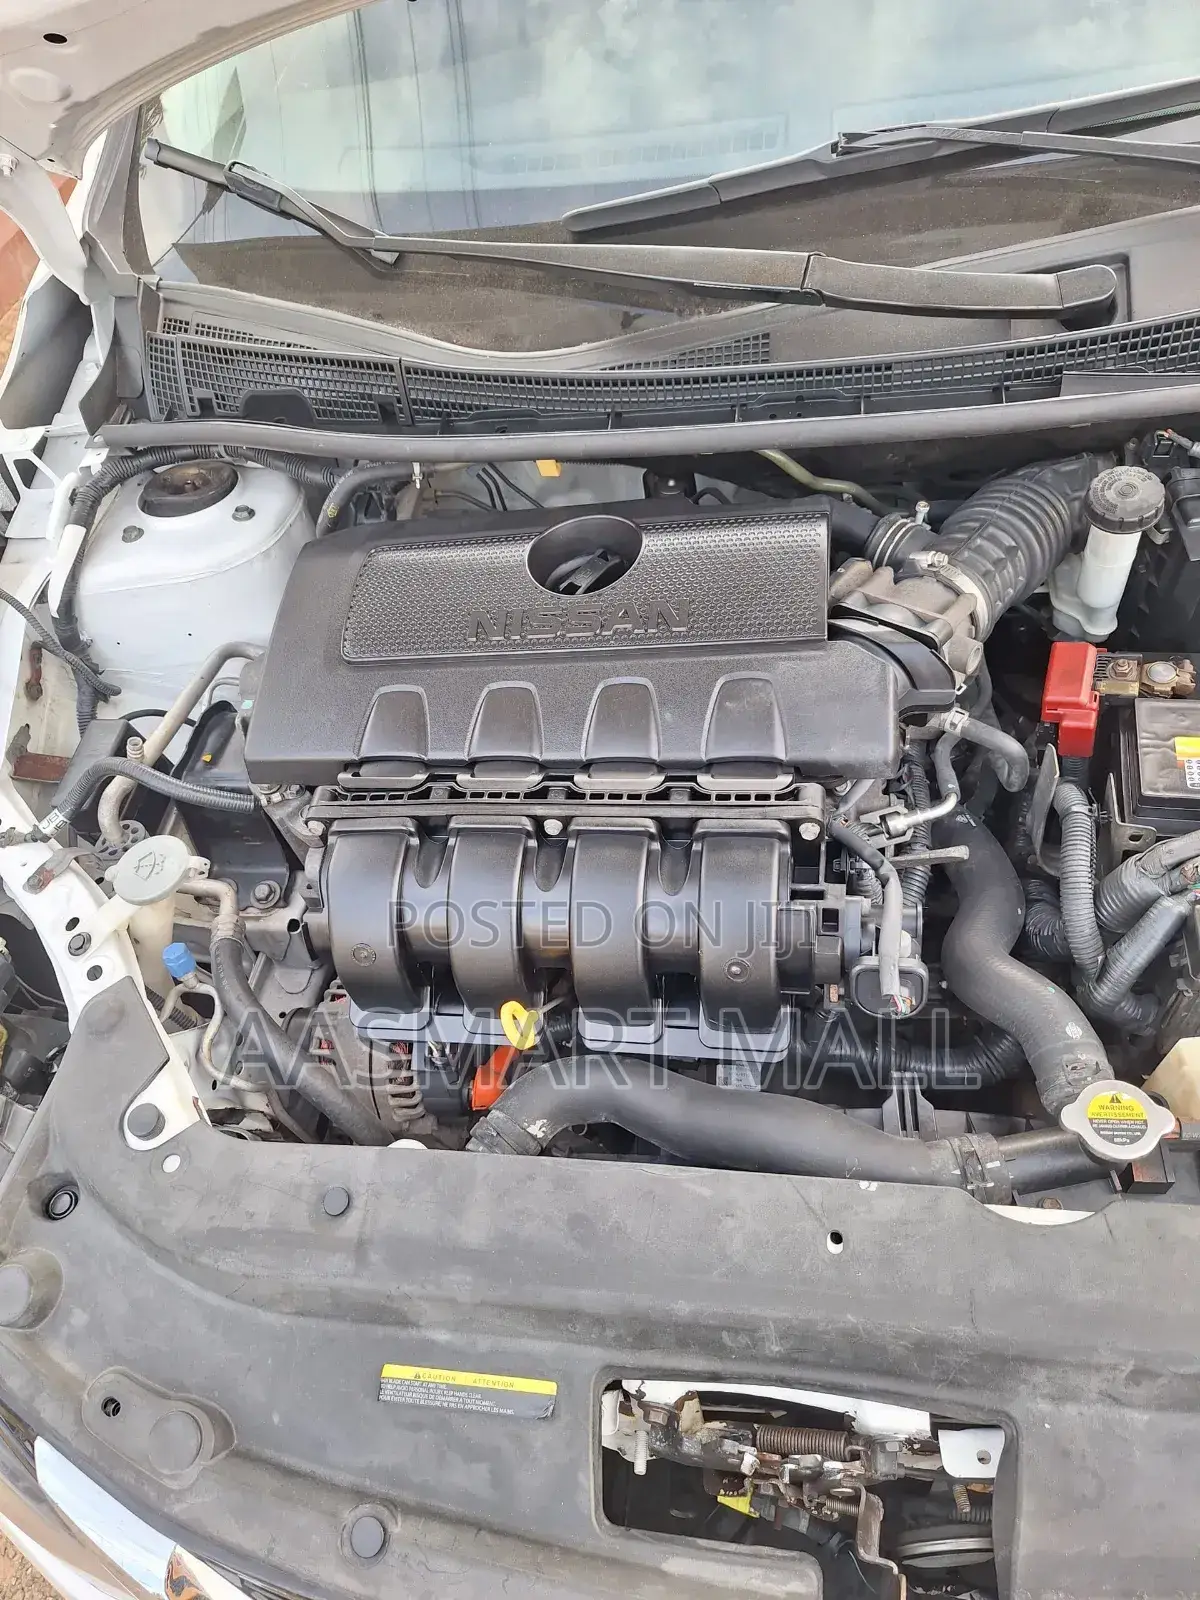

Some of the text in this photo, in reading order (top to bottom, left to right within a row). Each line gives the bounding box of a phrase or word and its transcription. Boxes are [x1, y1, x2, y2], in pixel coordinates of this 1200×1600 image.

[467, 600, 689, 641] NISSAN
[421, 1373, 515, 1388] CAUTION ATTENTION
